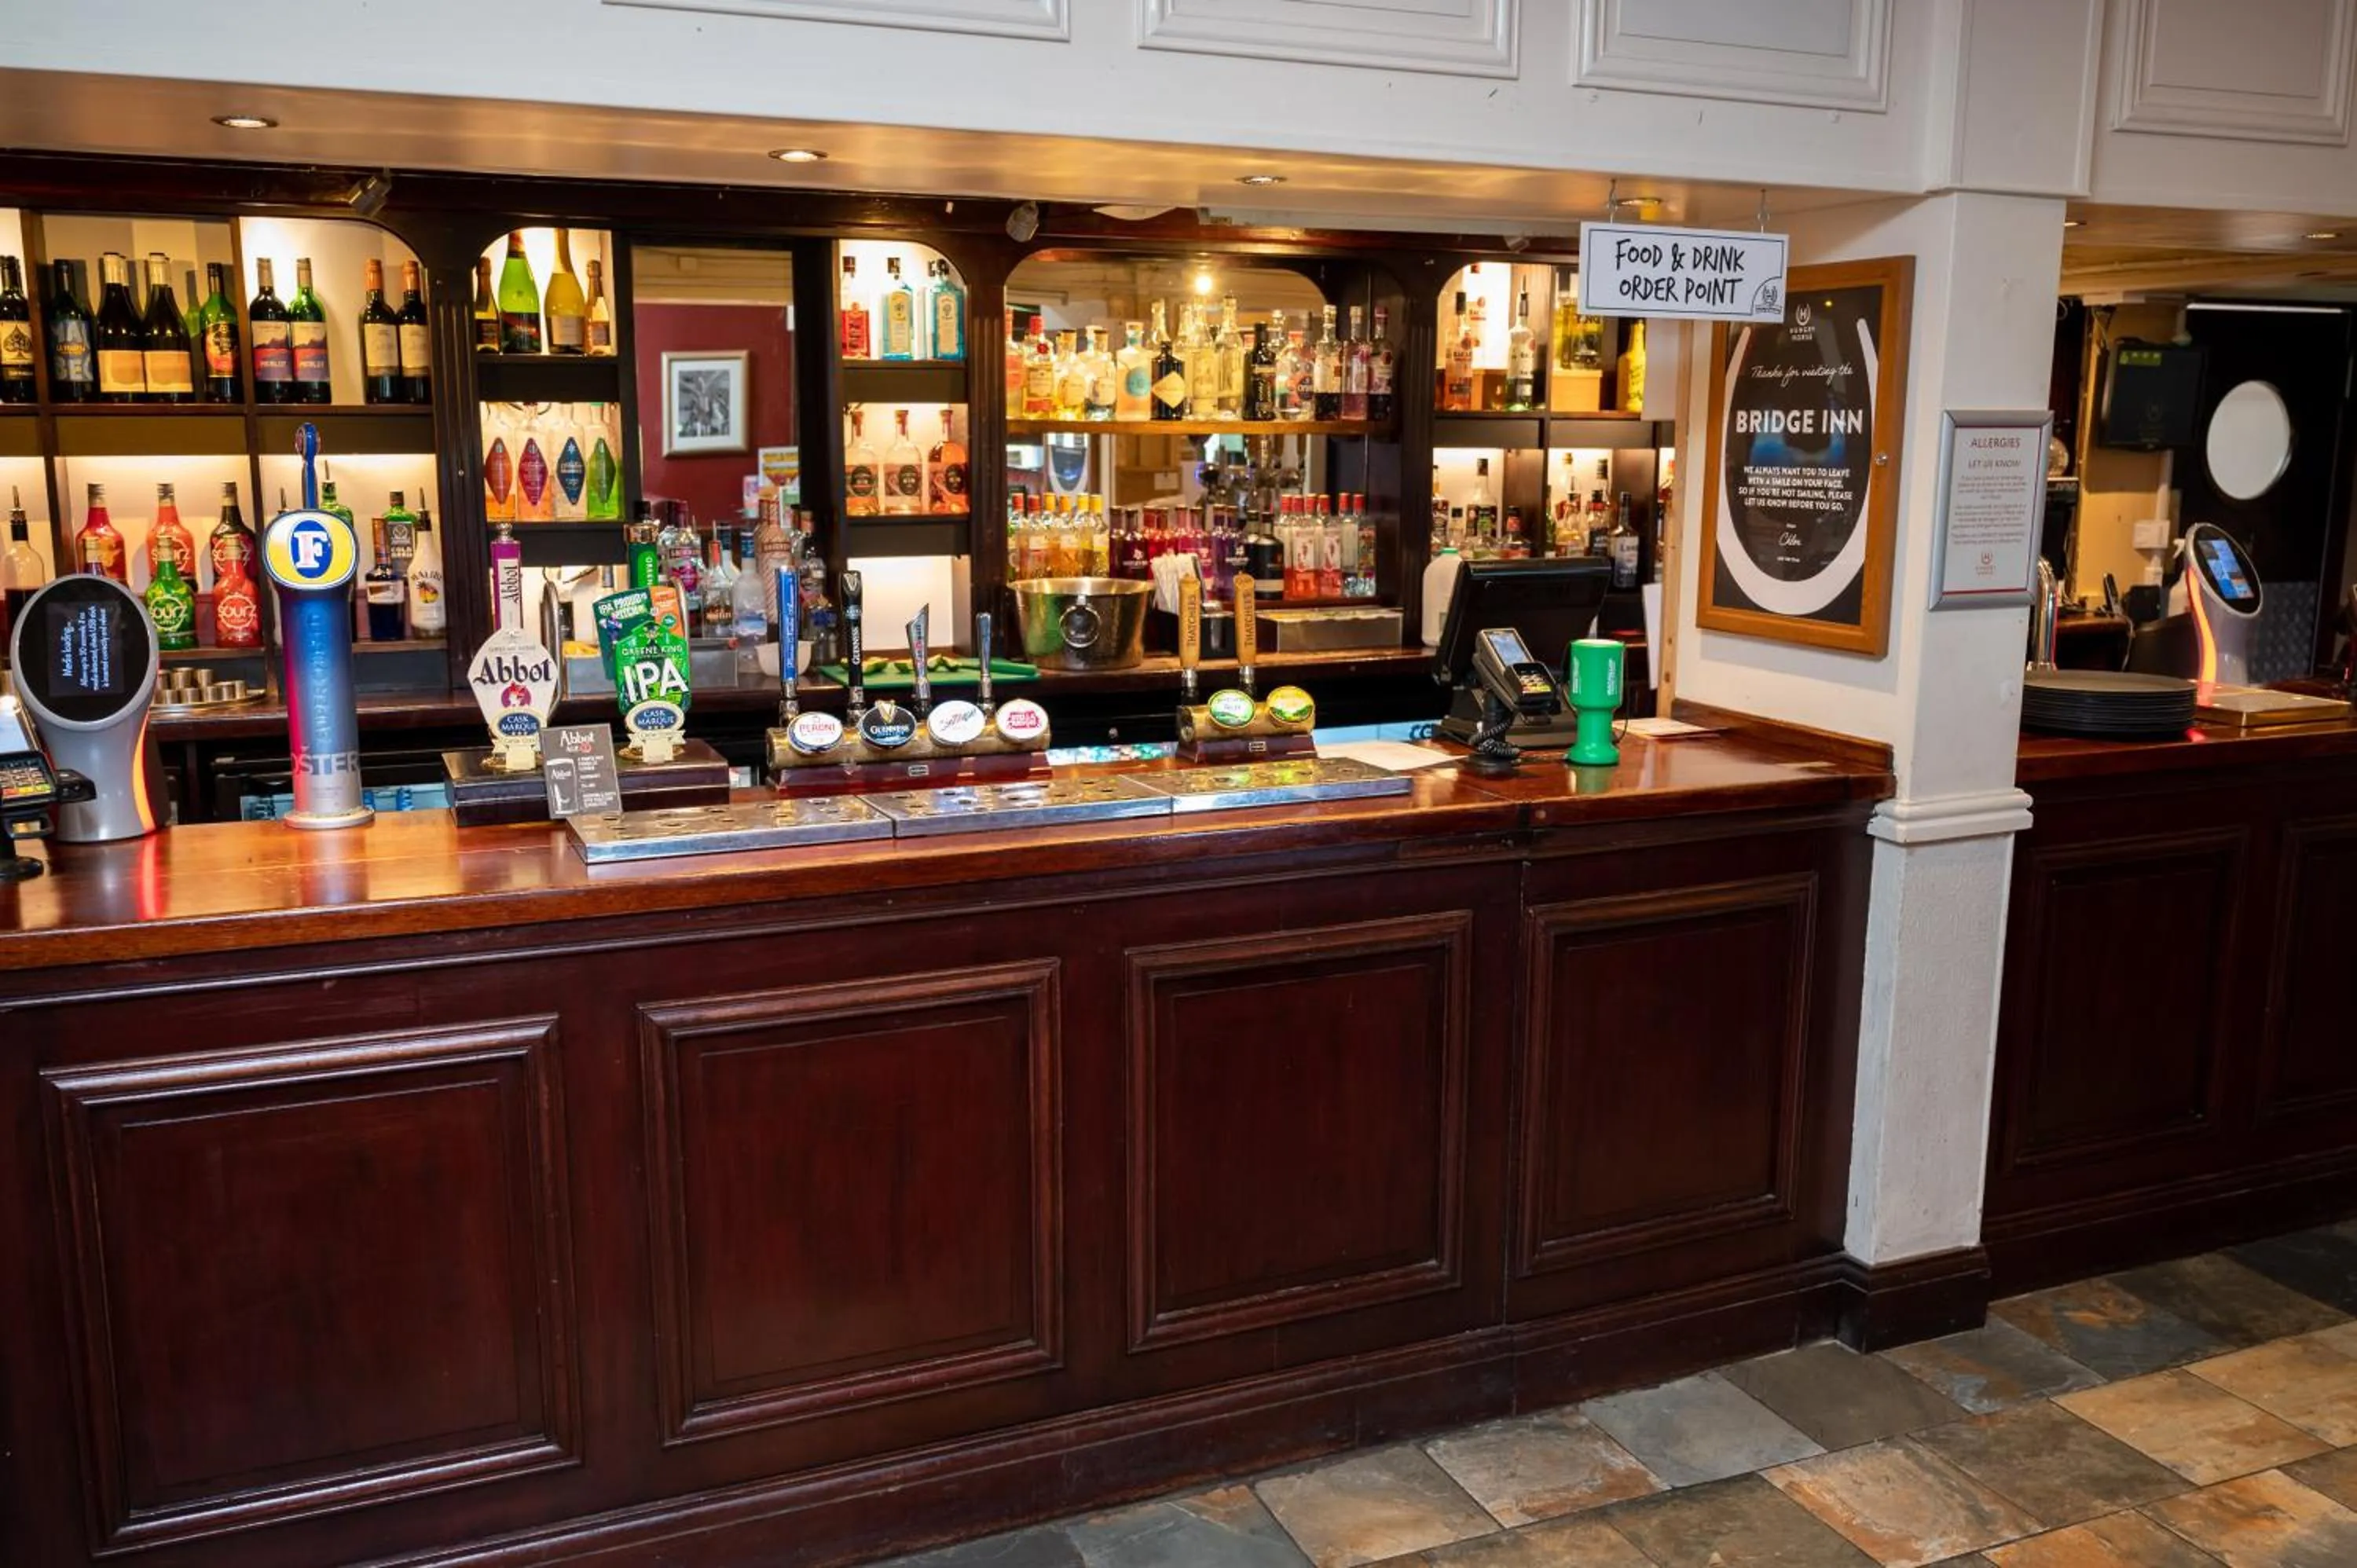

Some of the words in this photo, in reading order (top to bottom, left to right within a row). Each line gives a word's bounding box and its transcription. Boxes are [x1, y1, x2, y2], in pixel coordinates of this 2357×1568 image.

[1615, 238, 1663, 271] FOOD
[1671, 243, 1685, 272] &
[1692, 245, 1745, 274] DRINK
[1619, 274, 1679, 302] ORDER
[1685, 277, 1743, 306] POINT
[1750, 365, 1783, 379] Thanks
[1780, 365, 1799, 387] for
[1802, 365, 1837, 386] visiting
[1837, 362, 1853, 376] the
[1736, 409, 1815, 434] BRIDGE
[1822, 408, 1864, 434] INN
[1970, 438, 2022, 449] ALLERGIES
[1743, 466, 1754, 474] WE
[1754, 466, 1780, 475] ALWAYS
[1782, 467, 1801, 476] WANT
[1802, 467, 1816, 476] YOU
[1817, 468, 1827, 477] TO
[1828, 468, 1850, 478] LEAVE
[1968, 460, 1981, 469] LET
[1995, 459, 2022, 468] KNOW
[1748, 476, 1764, 485] WITH
[1772, 478, 1791, 486] SMILE
[1791, 478, 1802, 486] ON
[1803, 478, 1823, 487] YOUR
[1738, 486, 1748, 495] SO
[1782, 489, 1795, 497] NOT
[1828, 491, 1853, 500] PLEASE
[1744, 497, 1756, 506] LET
[1767, 498, 1787, 507] KNOW
[1789, 500, 1814, 509] BEFORE
[1815, 501, 1830, 510] YOU
[292, 530, 328, 569] F
[501, 565, 520, 604] Abbot
[1187, 595, 1197, 647] THATCHERS
[1244, 591, 1253, 647] THATCHERS
[621, 647, 658, 656] GREENE
[661, 644, 683, 654] KING
[851, 628, 860, 665] GUINNESS
[62, 654, 73, 676] Media
[473, 655, 553, 685] Abbot
[623, 658, 689, 703] IPA
[507, 715, 529, 724] CASK
[637, 716, 675, 727] MARQUE
[643, 709, 666, 718] CASK
[501, 722, 538, 732] MARQUE
[799, 722, 836, 733] PERONI
[871, 724, 909, 735] GUINNESS
[560, 730, 595, 747] Abbot
[290, 751, 361, 775] OSTER
